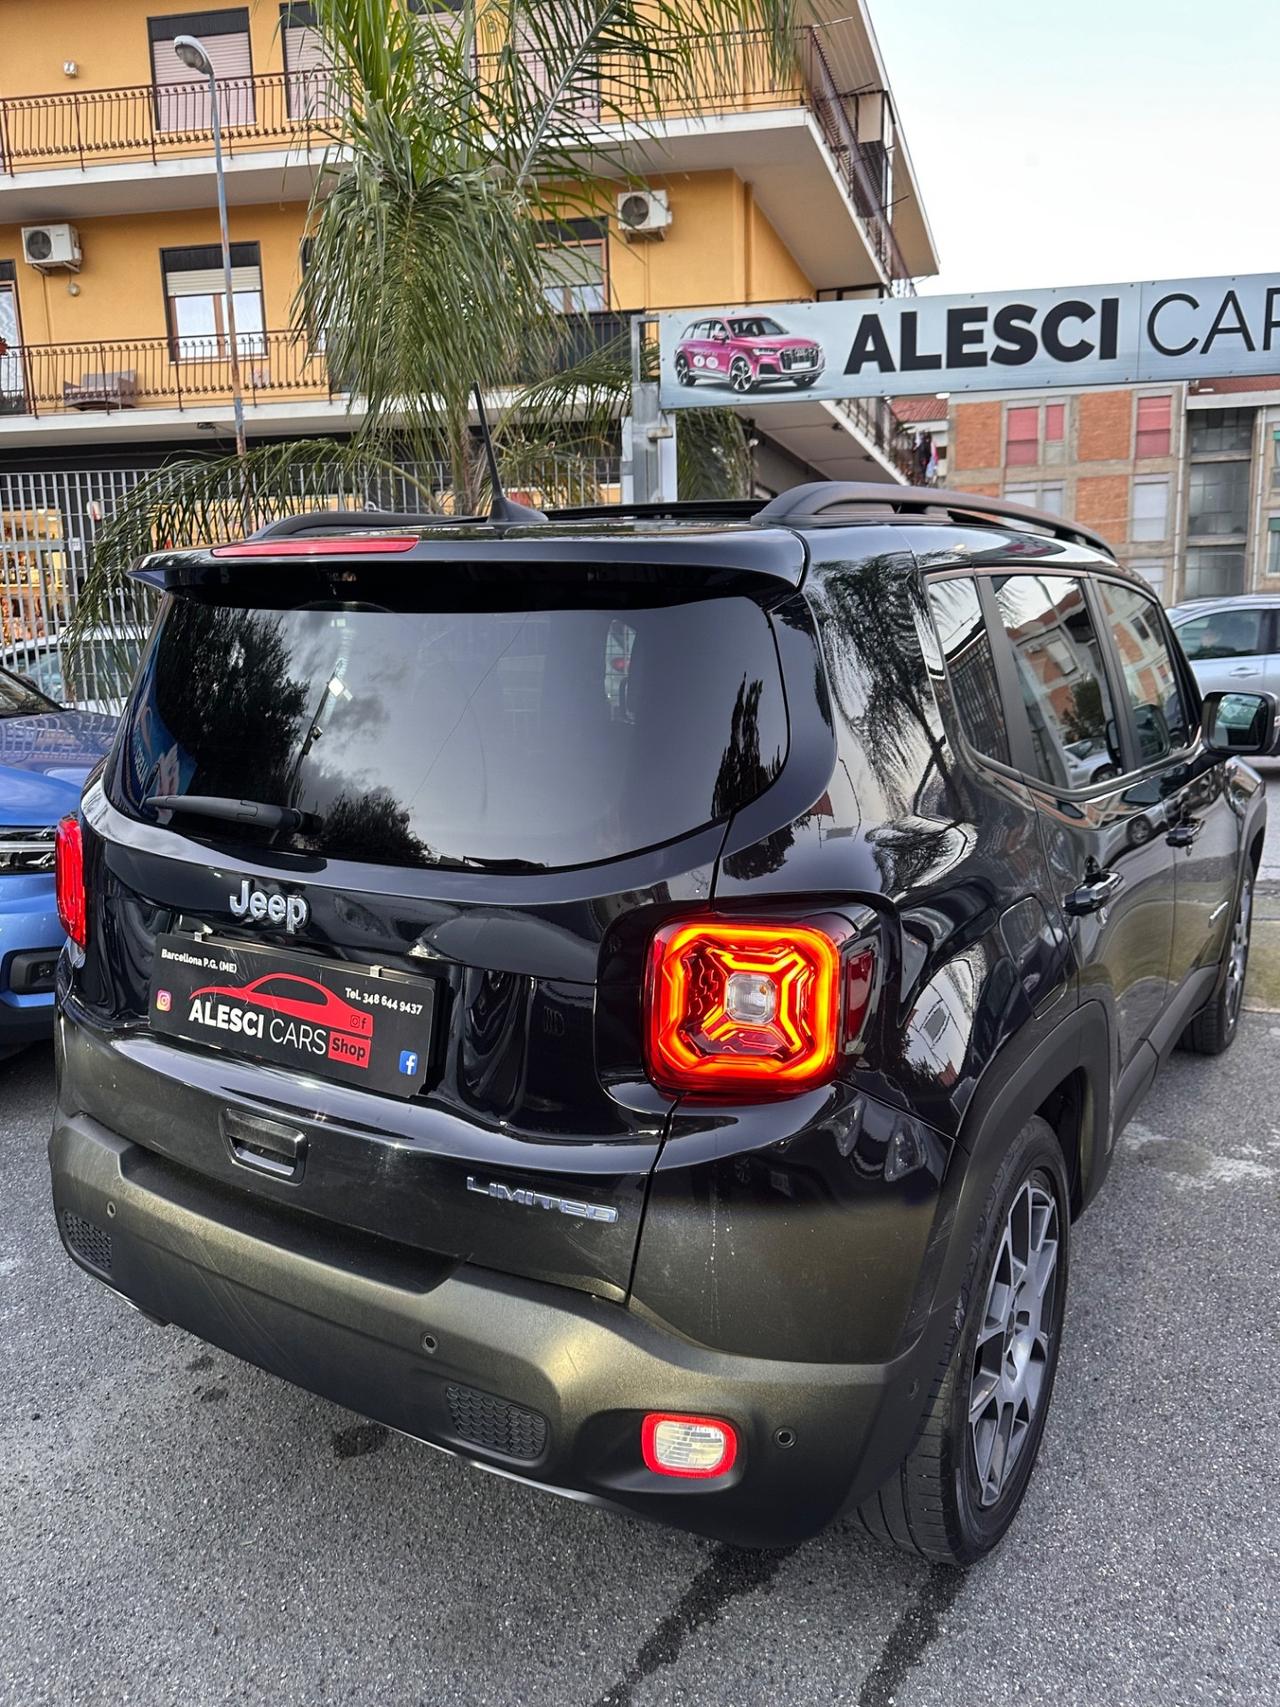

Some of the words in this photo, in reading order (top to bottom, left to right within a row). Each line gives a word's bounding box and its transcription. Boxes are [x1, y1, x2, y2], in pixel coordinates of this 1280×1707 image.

[844, 297, 1119, 375] ALESCI
[229, 879, 309, 935] Jeep
[161, 948, 203, 967] Barcellona
[203, 957, 218, 970] P.G.
[219, 960, 238, 974] (ME)
[345, 987, 361, 1001] Tel.
[362, 993, 380, 1005] 348
[381, 995, 398, 1010] 644
[399, 1001, 423, 1015] 9437
[188, 999, 264, 1038] ALESCI
[269, 1018, 327, 1055] CARS
[331, 1037, 366, 1061] Shop
[467, 1177, 619, 1223] LIMITED
